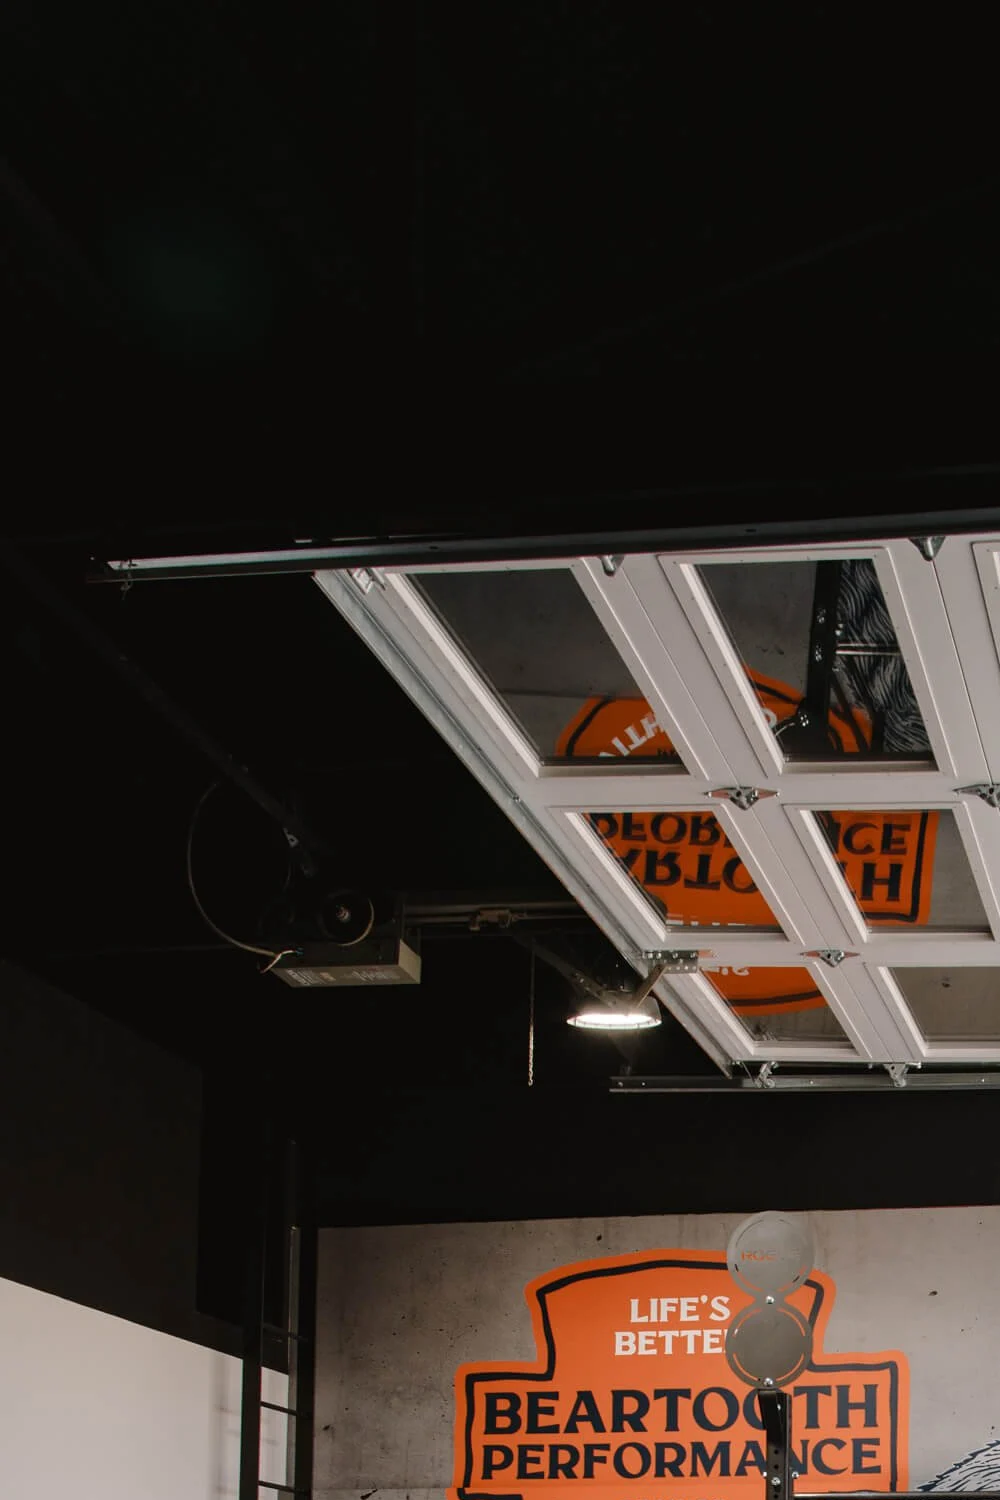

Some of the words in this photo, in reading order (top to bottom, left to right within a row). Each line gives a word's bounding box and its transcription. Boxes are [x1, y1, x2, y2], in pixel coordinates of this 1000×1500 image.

[630, 1294, 731, 1323] LIFE'S
[614, 1329, 729, 1356] BETTE
[481, 1437, 882, 1480] PERFORMANCE
